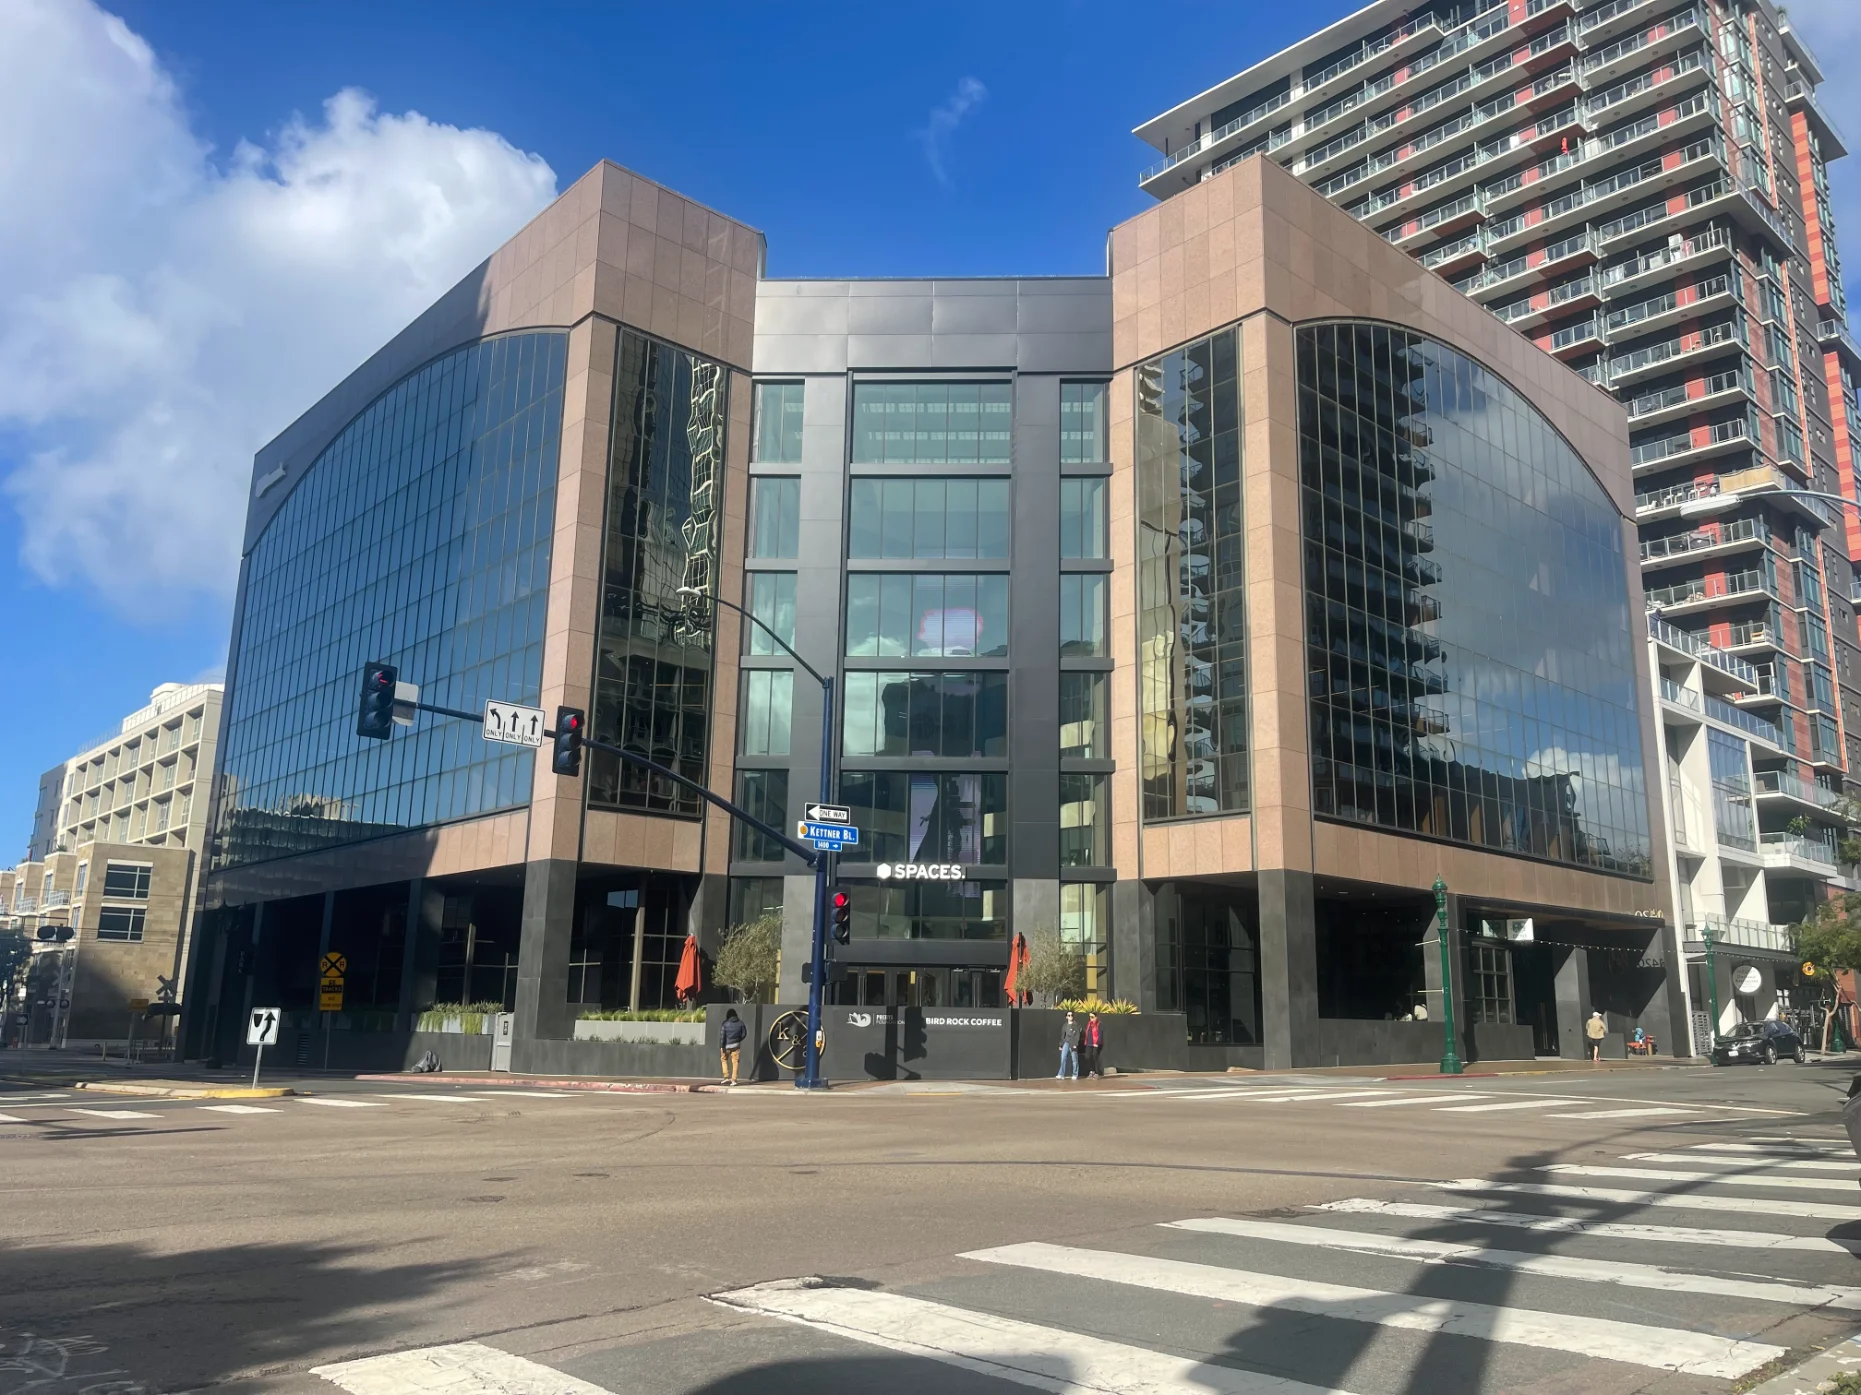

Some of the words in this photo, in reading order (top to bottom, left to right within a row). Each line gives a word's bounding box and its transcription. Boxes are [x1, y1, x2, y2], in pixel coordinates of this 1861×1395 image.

[485, 729, 502, 737] ONLY
[505, 732, 521, 740] ONLY
[523, 735, 540, 744] ONLY
[819, 809, 832, 818] ONE
[833, 811, 846, 819] WAY
[809, 825, 841, 840] KETTNER
[843, 828, 856, 841] BL.
[925, 1017, 946, 1026] BIRD
[946, 1017, 970, 1026] ROCK
[970, 1017, 1003, 1026] COFFEE
